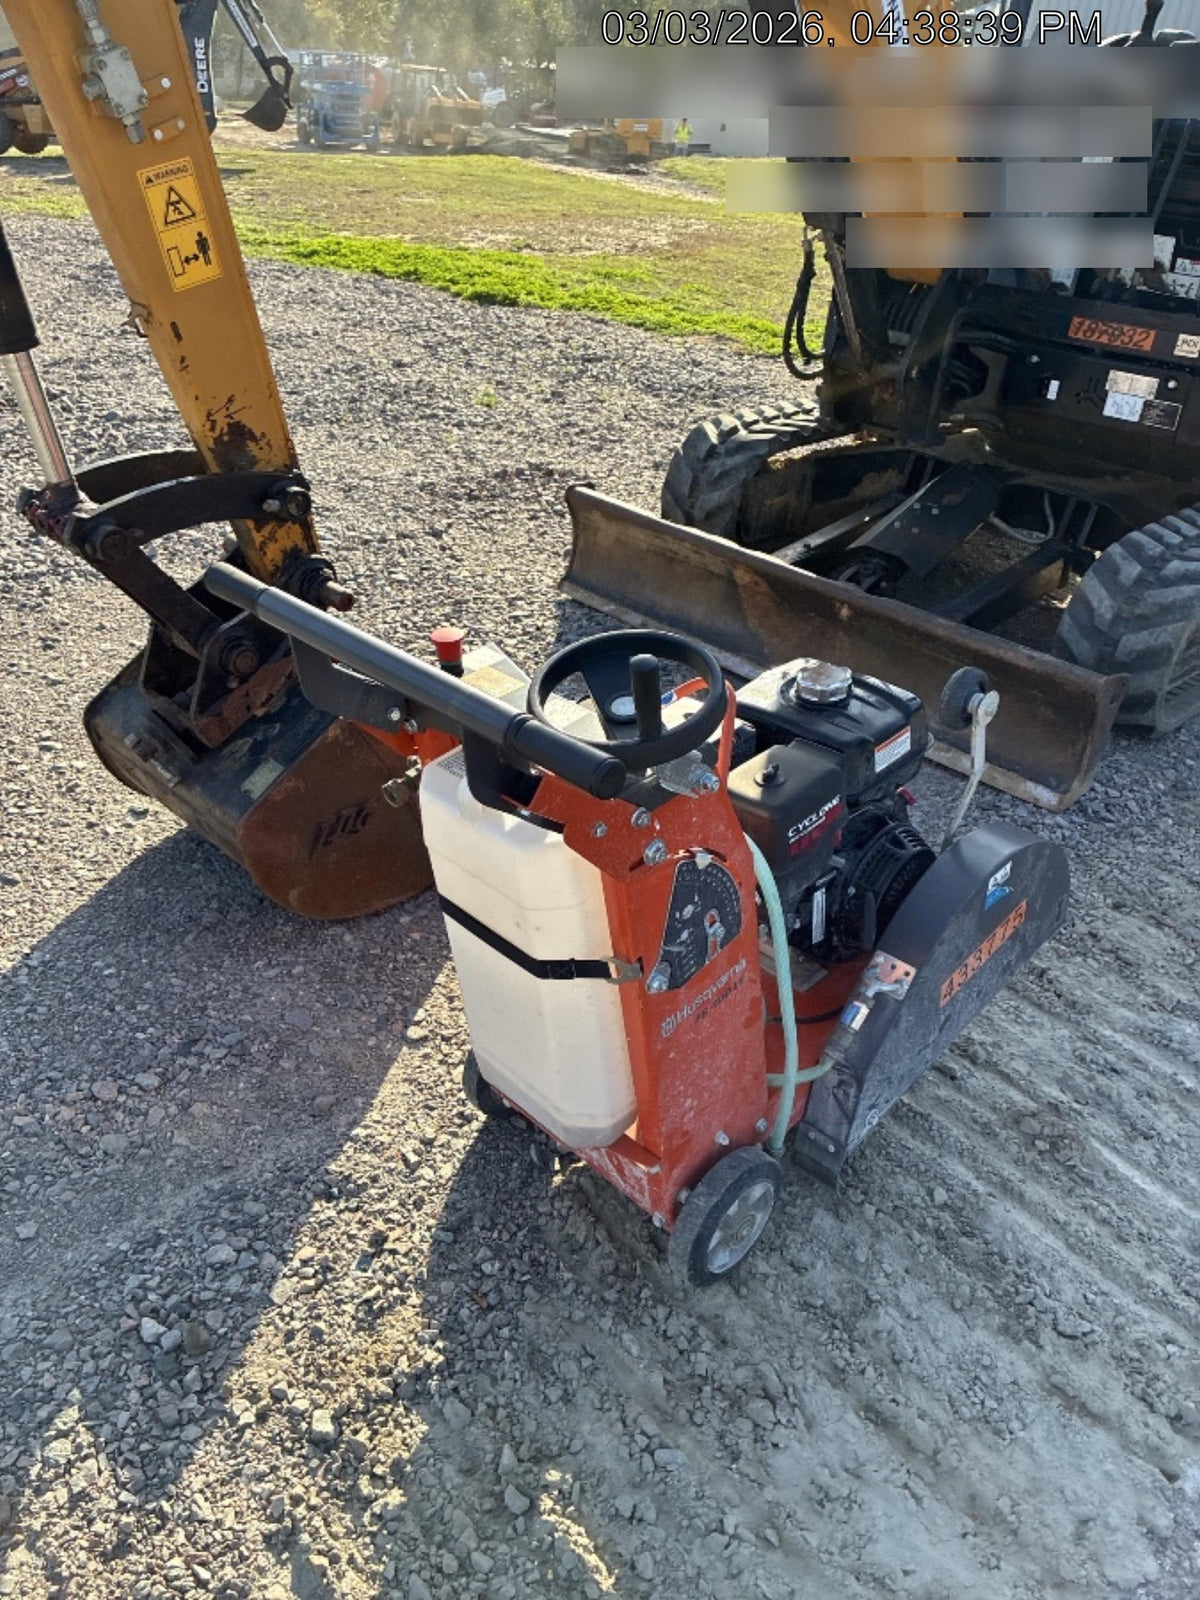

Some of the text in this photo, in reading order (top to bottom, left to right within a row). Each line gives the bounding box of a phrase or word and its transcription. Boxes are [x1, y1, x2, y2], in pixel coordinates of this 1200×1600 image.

[194, 37, 209, 94] DEERE
[152, 164, 190, 182] WARNING
[942, 903, 1025, 1000] 433775
[676, 957, 747, 1023] Husqvarna
